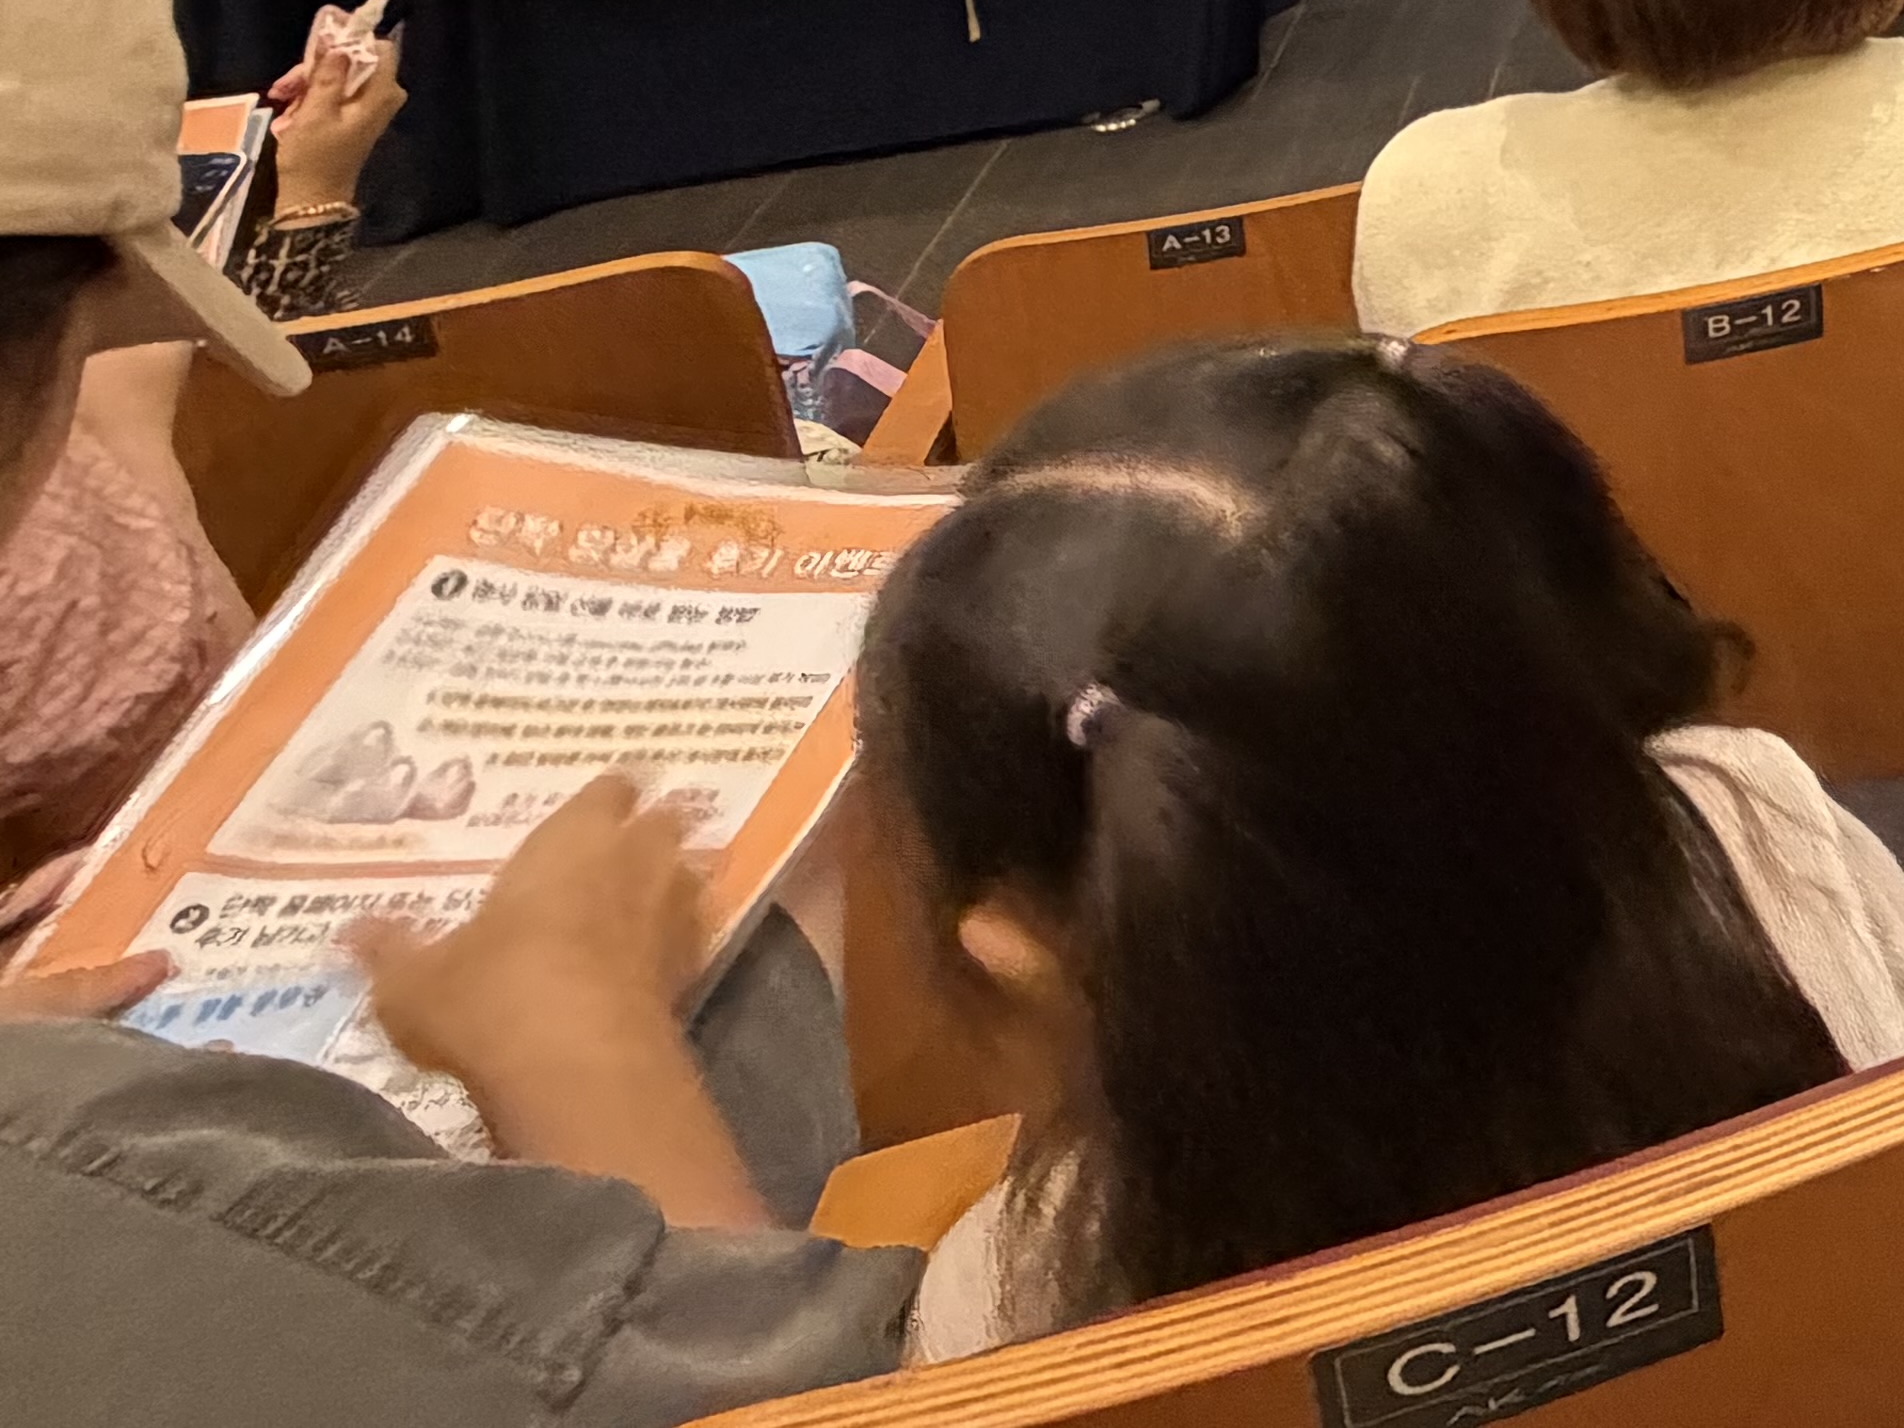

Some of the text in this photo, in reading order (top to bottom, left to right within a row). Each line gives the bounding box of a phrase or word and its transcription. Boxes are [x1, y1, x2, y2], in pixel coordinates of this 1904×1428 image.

[1162, 225, 1231, 253] A-13
[1706, 298, 1801, 338] B-12
[323, 325, 415, 354] A-14
[1388, 1270, 1660, 1396] C-12
